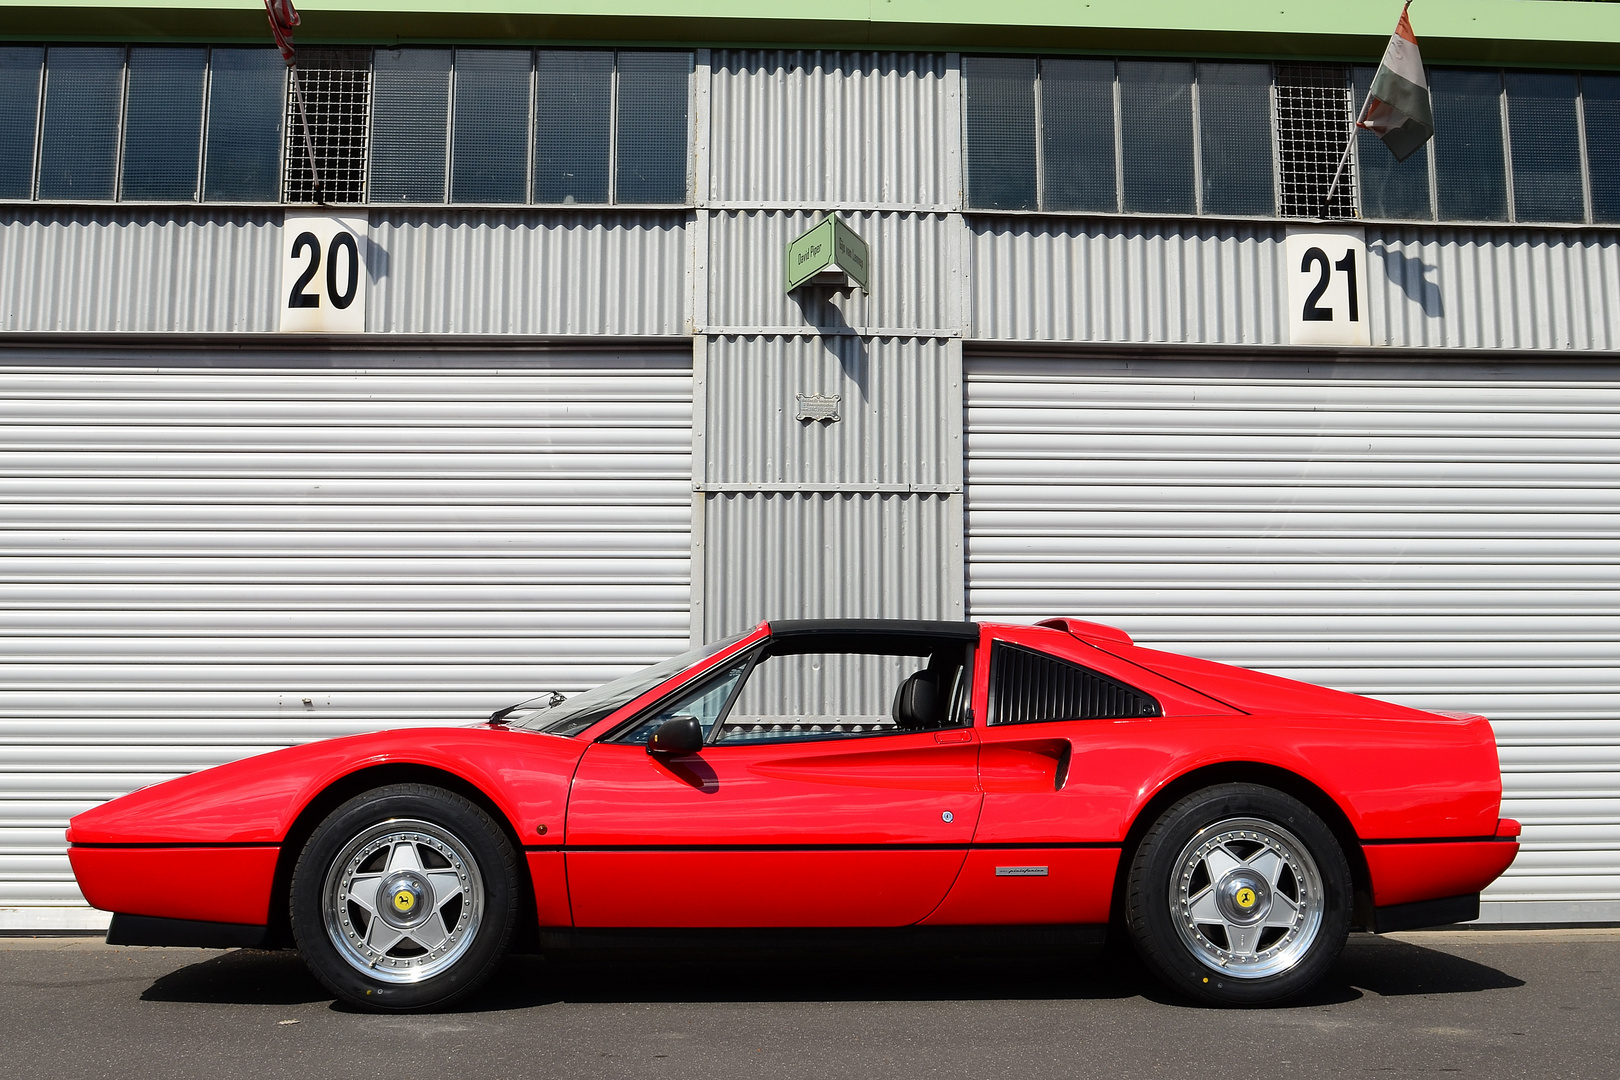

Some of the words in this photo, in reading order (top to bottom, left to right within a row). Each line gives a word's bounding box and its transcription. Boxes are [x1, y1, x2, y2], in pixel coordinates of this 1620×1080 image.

[288, 231, 359, 309] 20
[798, 247, 810, 265] David
[810, 244, 822, 258] Piper
[1300, 246, 1359, 322] 21
